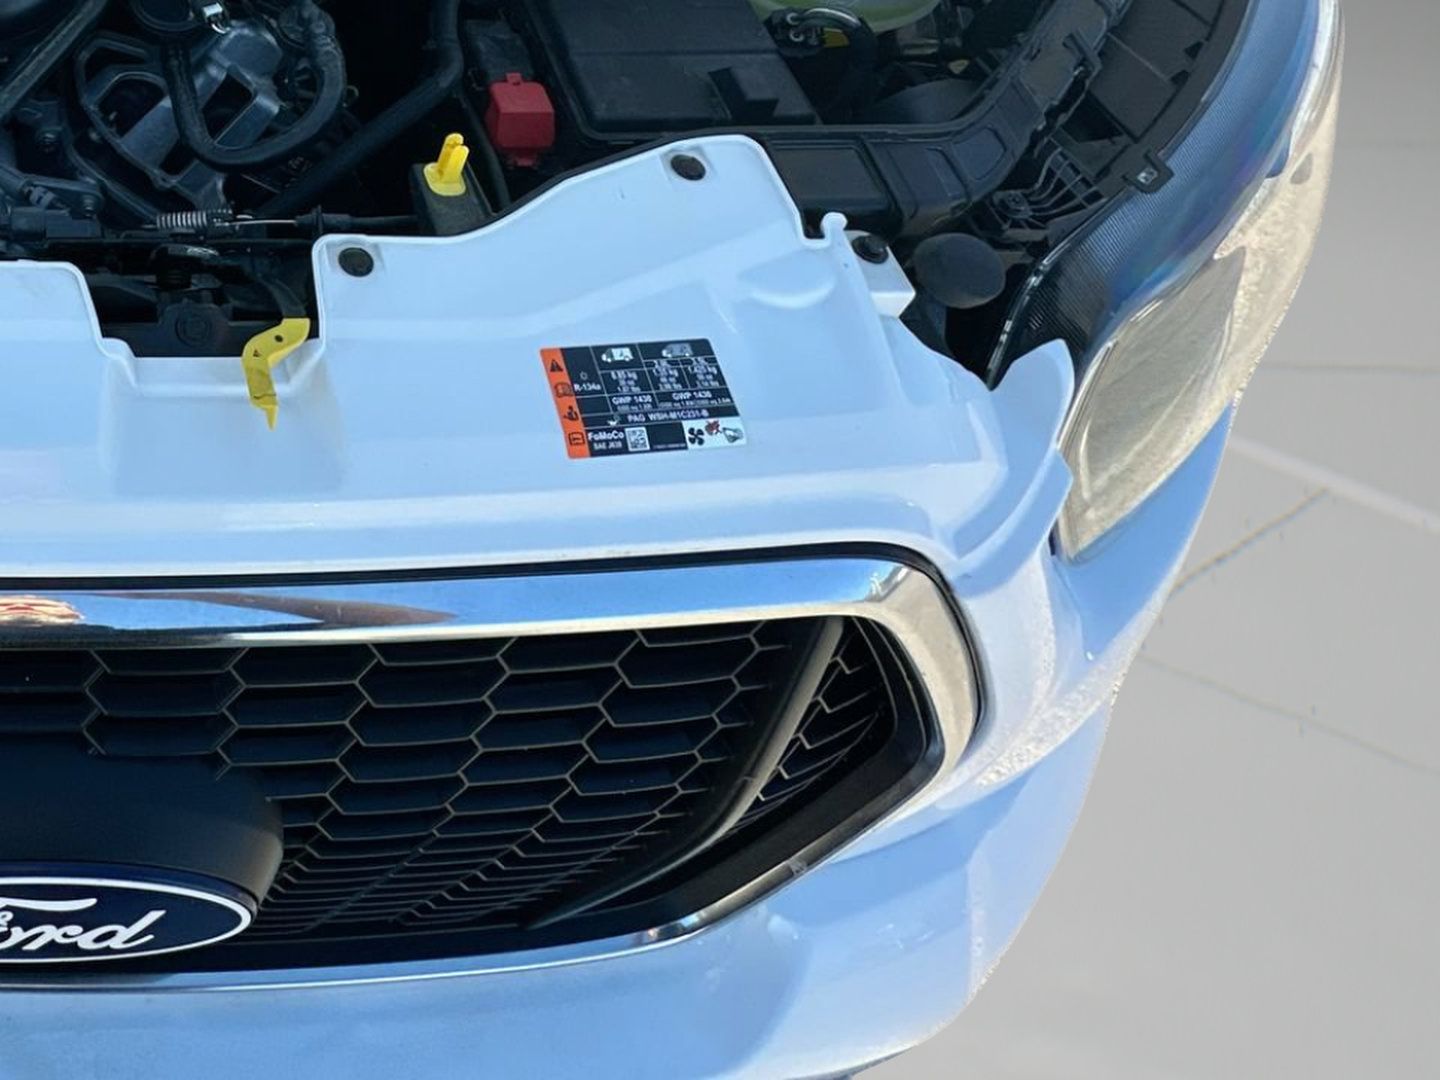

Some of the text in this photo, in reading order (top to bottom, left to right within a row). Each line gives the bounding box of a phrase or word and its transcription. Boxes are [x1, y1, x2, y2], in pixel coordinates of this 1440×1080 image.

[574, 382, 602, 391] R-134a
[612, 396, 632, 405] GWP
[633, 394, 653, 403] 1430
[672, 390, 713, 400] GWP 1430
[587, 430, 625, 441] FoMoCo
